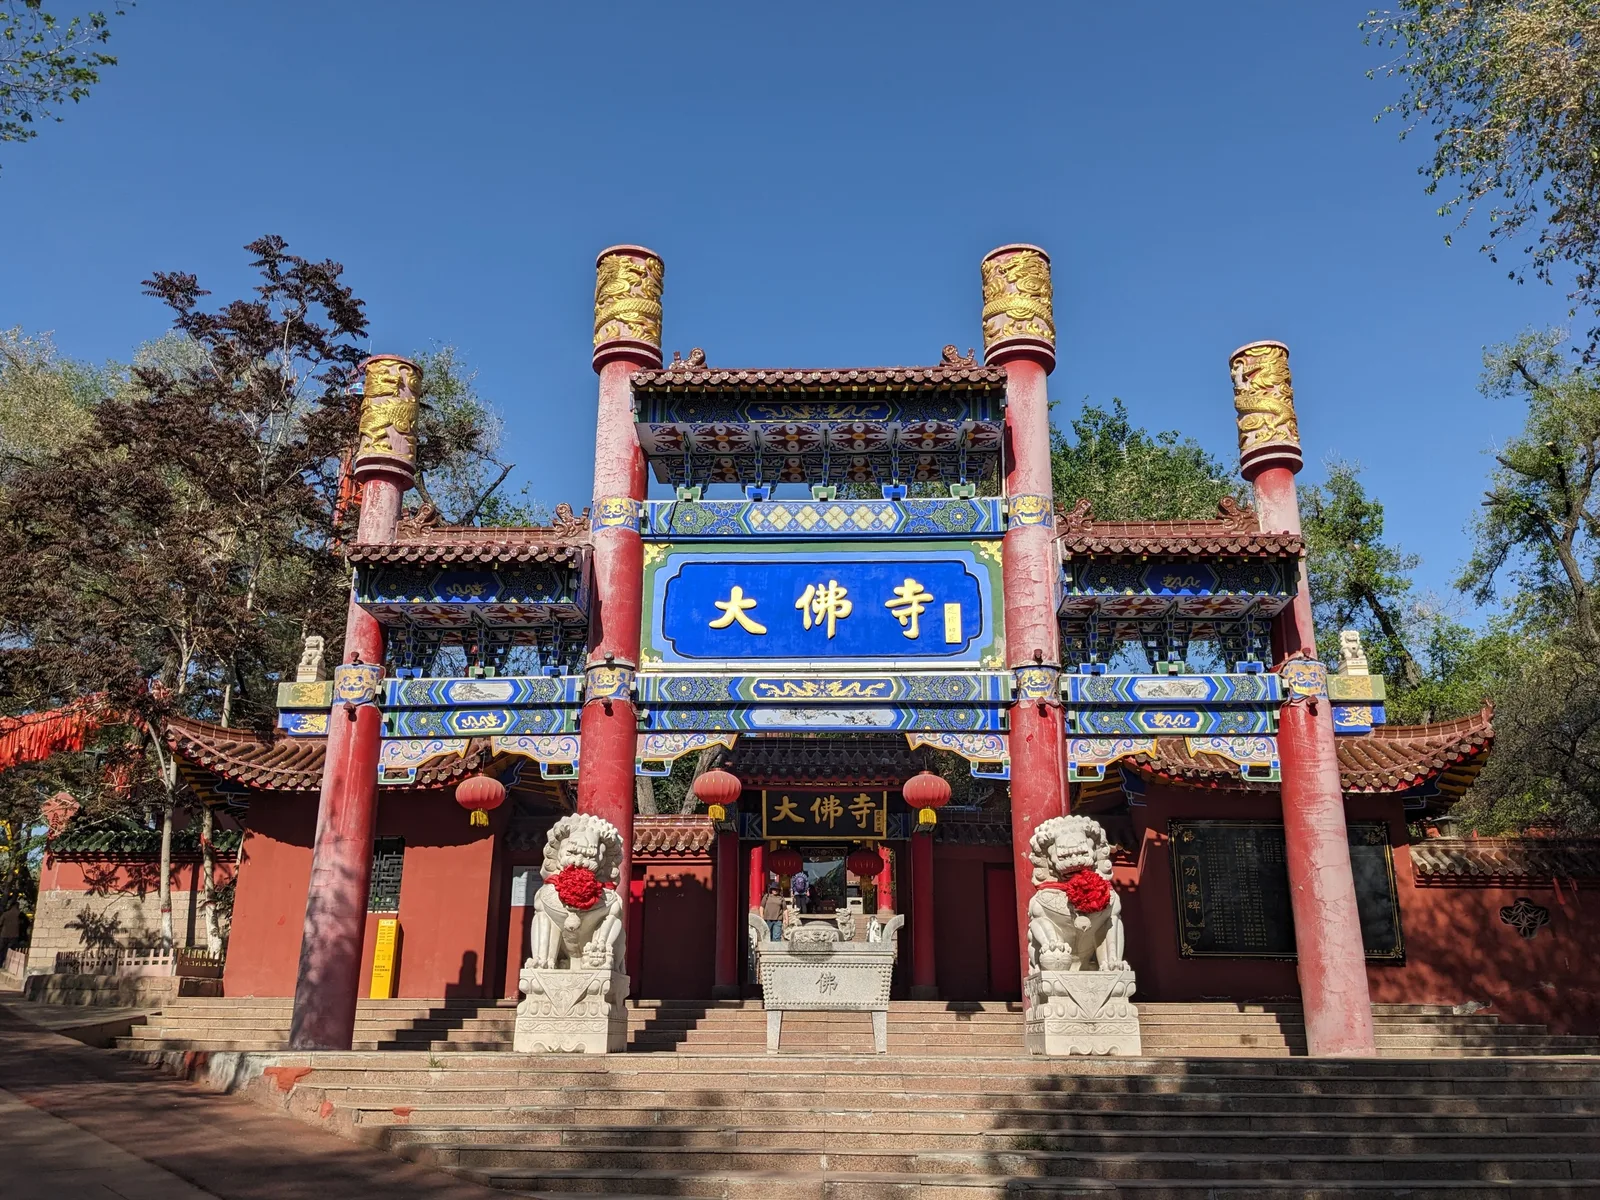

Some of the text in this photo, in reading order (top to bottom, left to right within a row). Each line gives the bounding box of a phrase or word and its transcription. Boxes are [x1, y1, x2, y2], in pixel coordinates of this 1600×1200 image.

[709, 578, 934, 640] 大佛寺
[771, 793, 876, 829] 大佛寺
[1184, 865, 1201, 914] 功德碑
[815, 971, 838, 996] 佛
